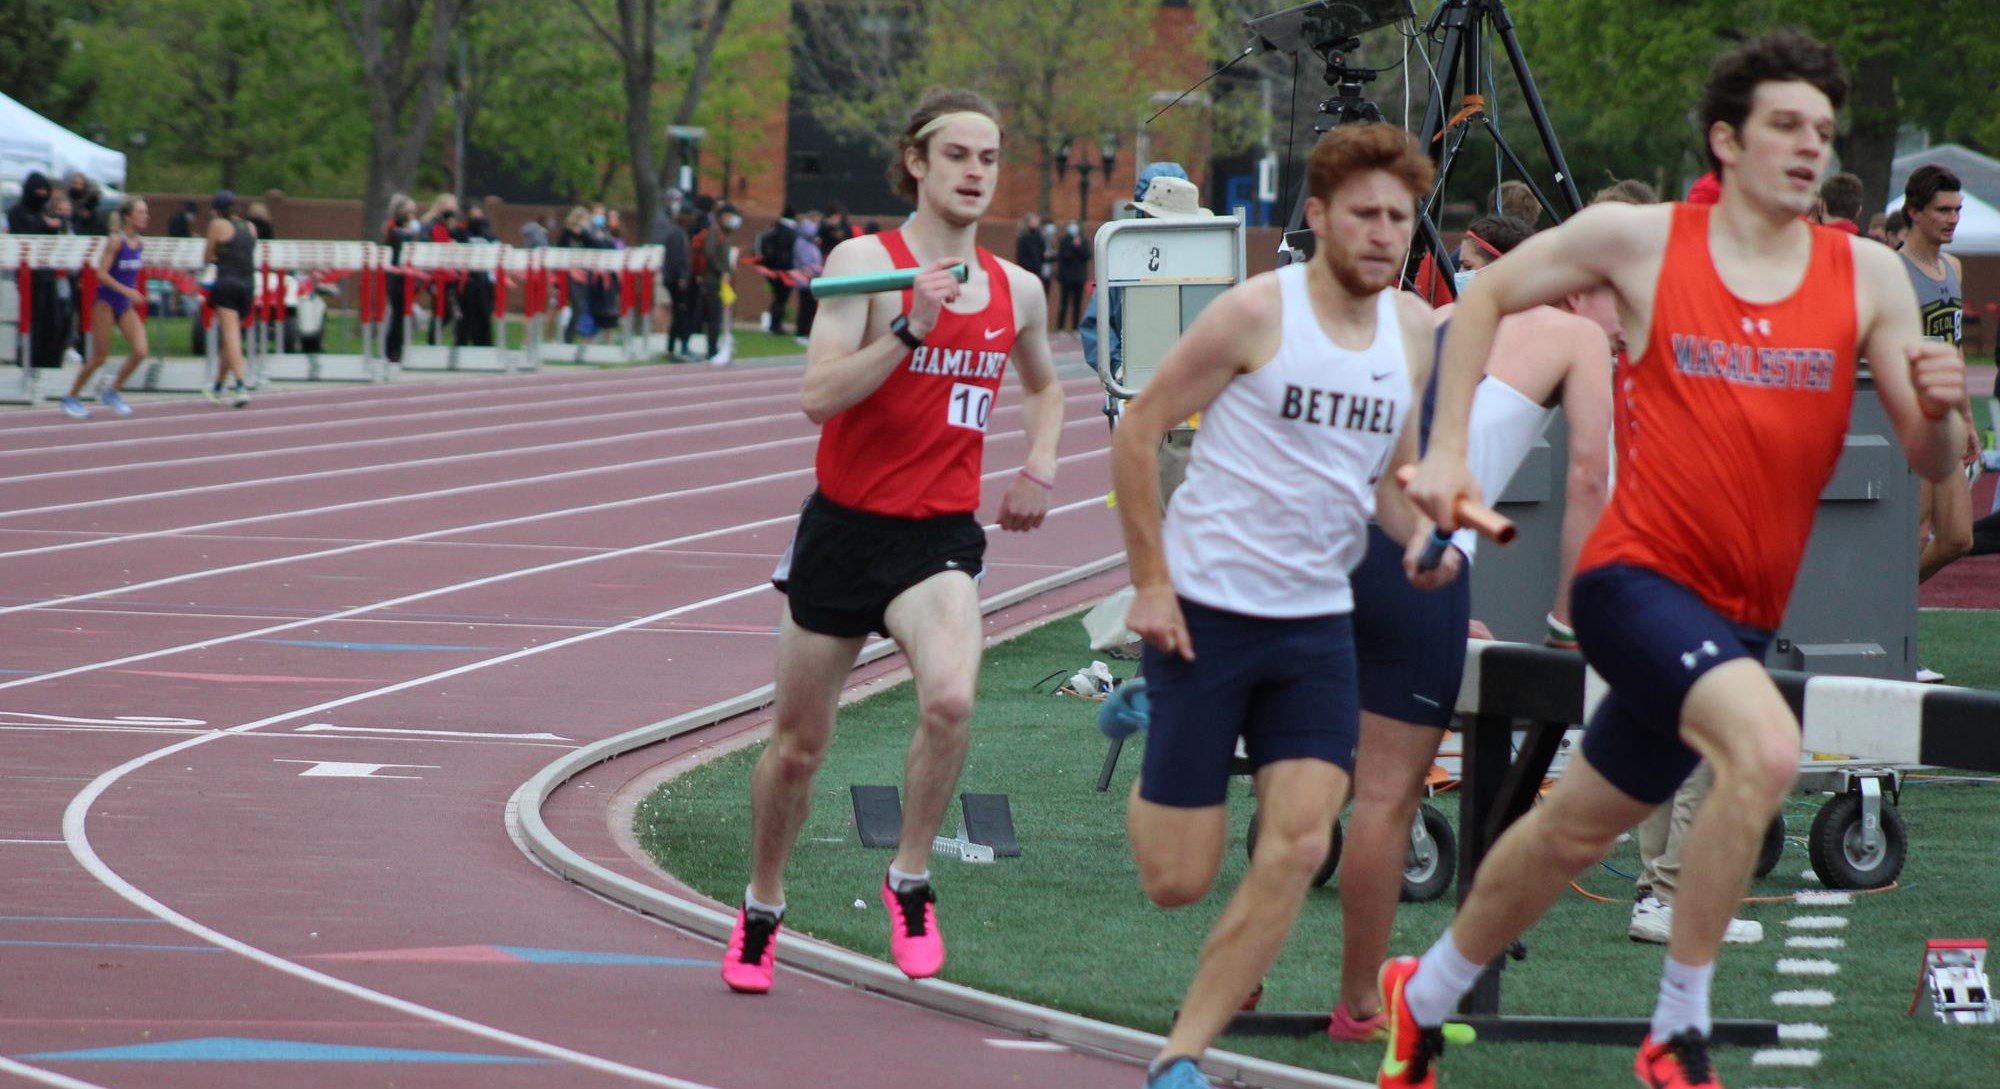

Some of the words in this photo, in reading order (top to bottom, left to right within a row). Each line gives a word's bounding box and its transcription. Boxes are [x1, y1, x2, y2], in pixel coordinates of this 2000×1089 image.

[1671, 333, 1836, 391] MACALESTER
[954, 388, 990, 428] 10
[1280, 383, 1395, 434] BETHEL
